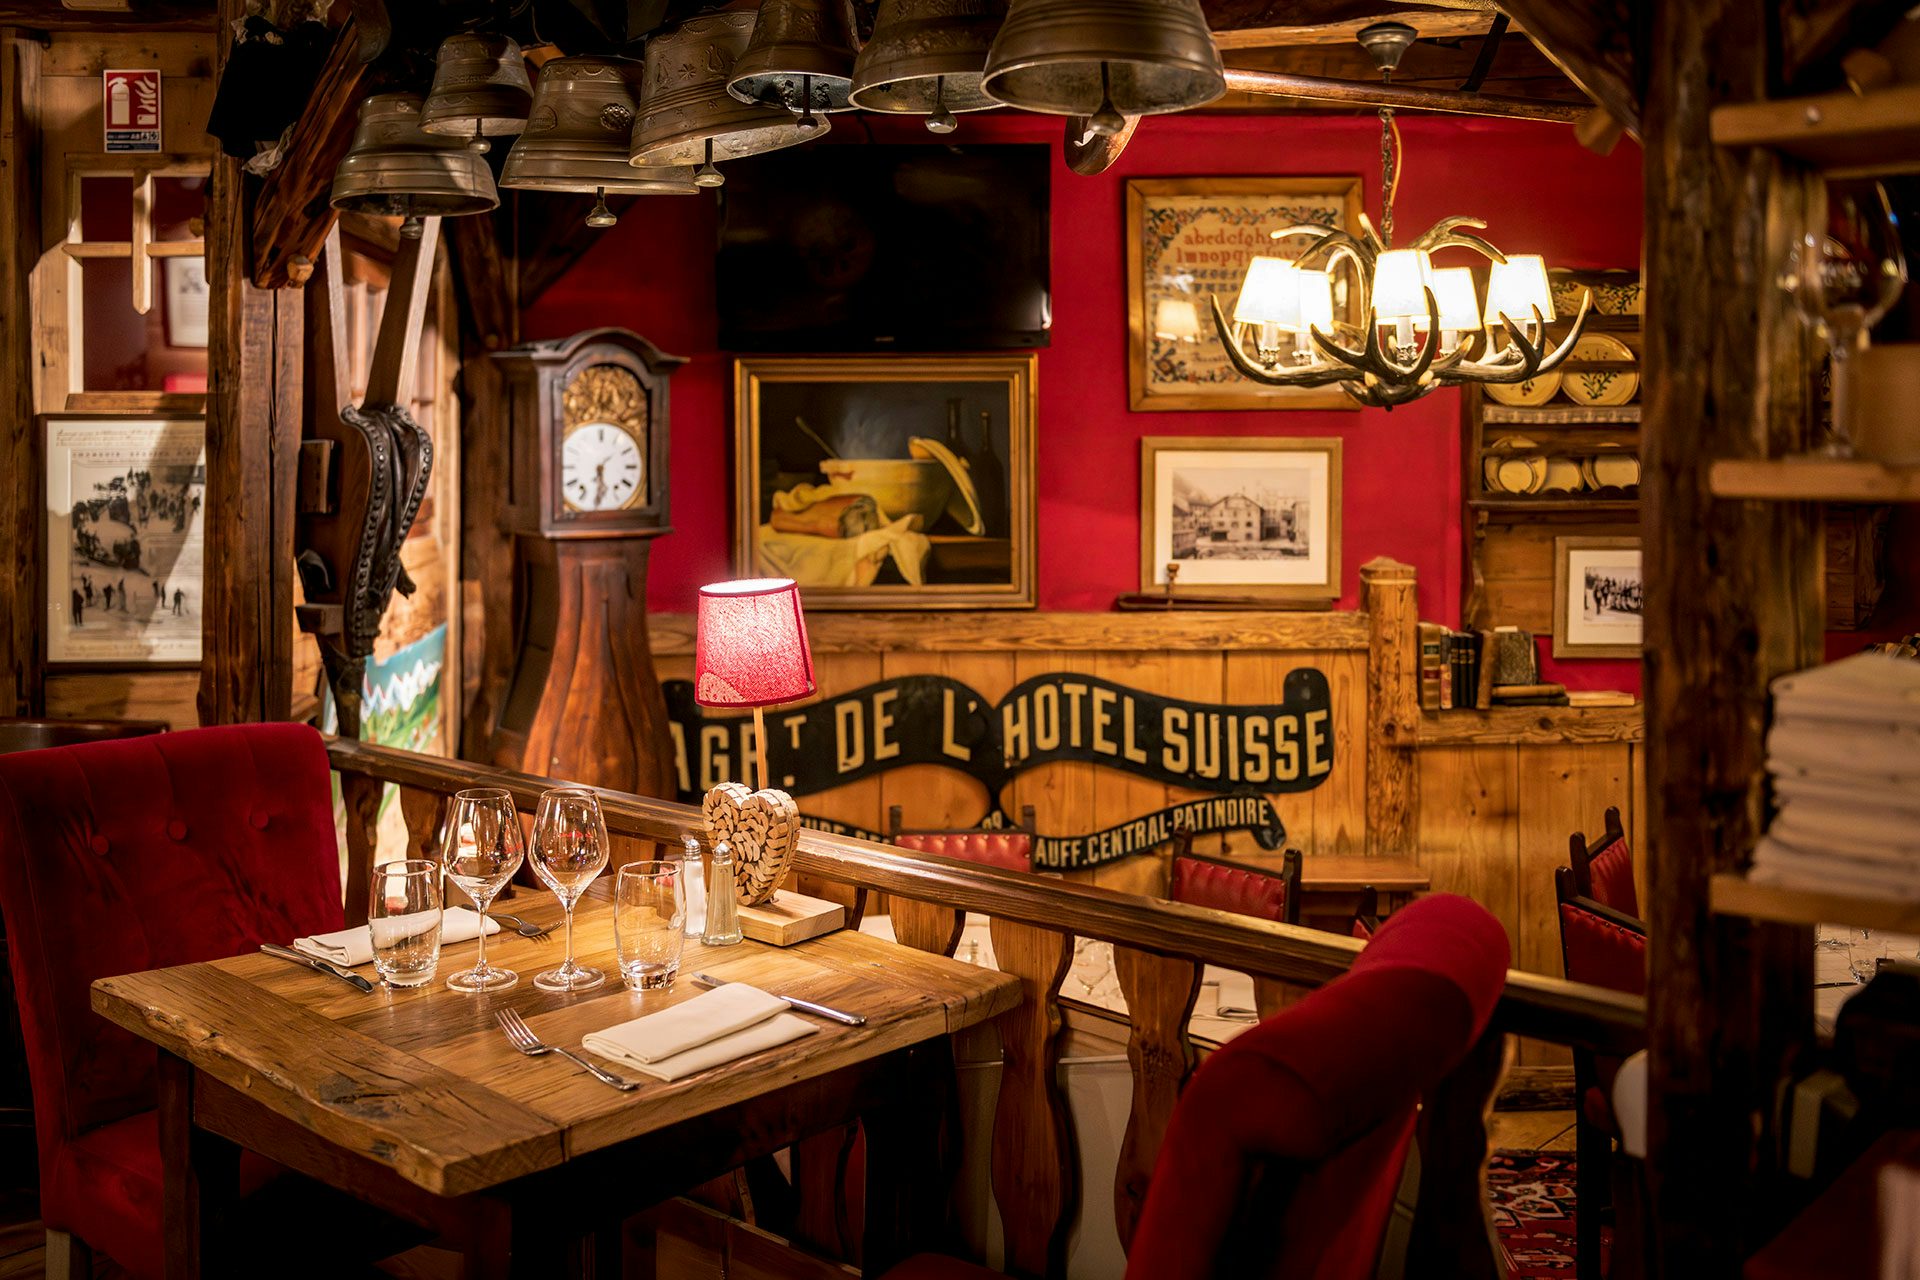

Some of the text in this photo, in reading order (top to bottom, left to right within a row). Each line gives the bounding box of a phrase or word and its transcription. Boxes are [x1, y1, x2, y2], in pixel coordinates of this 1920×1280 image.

[834, 688, 901, 774] DE
[1002, 682, 1148, 769] HOTEL
[1162, 707, 1331, 783] SUISSE
